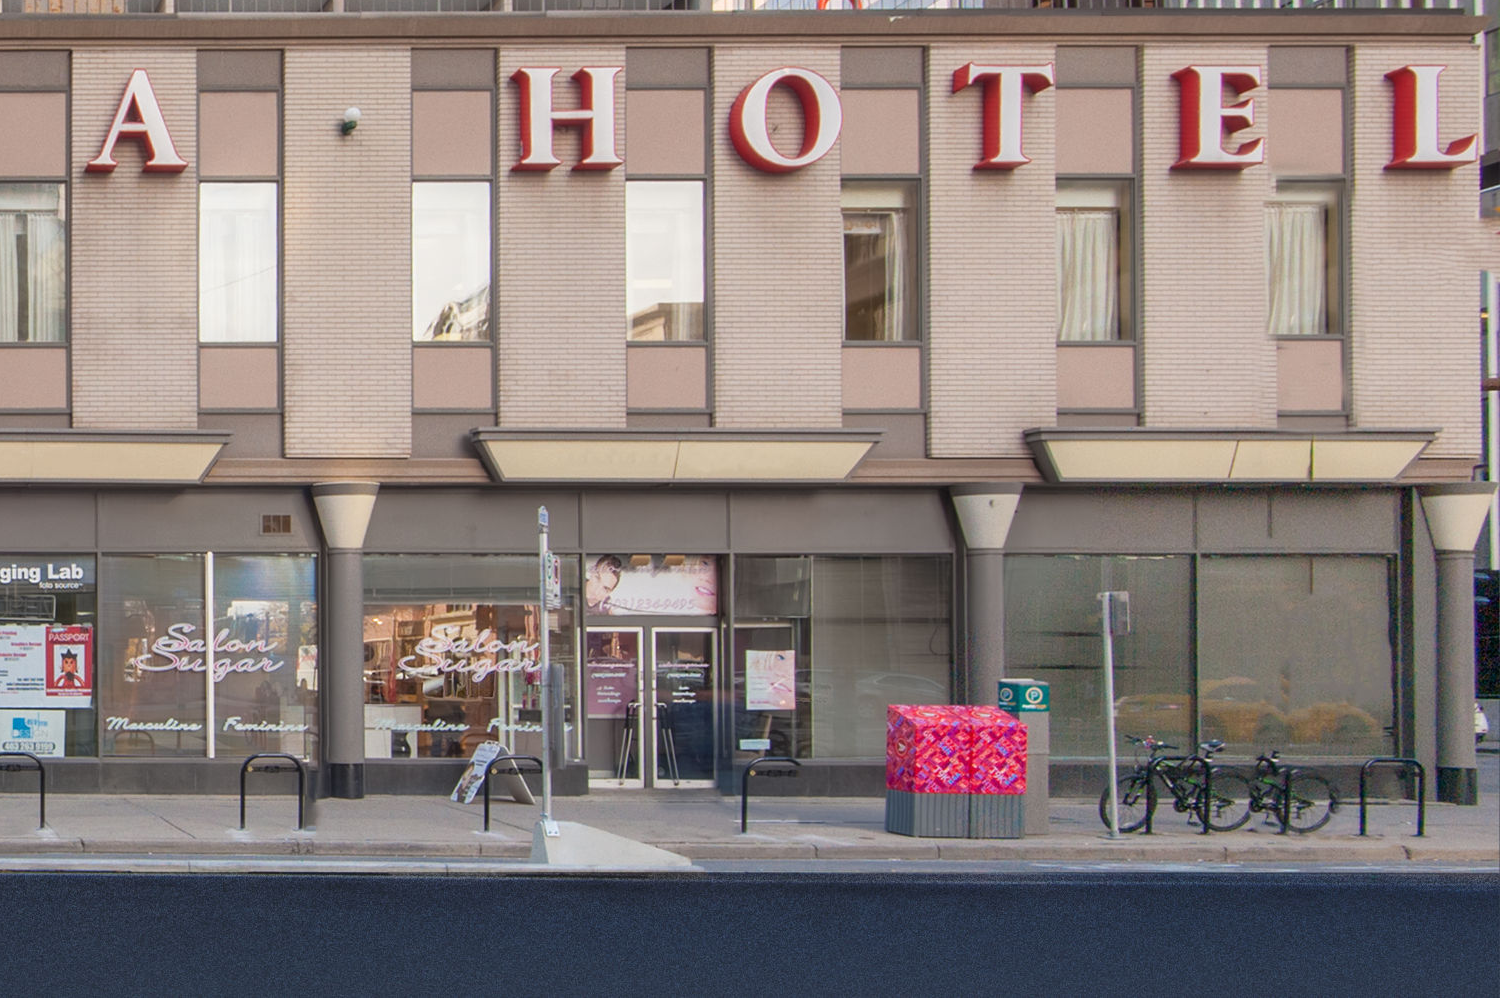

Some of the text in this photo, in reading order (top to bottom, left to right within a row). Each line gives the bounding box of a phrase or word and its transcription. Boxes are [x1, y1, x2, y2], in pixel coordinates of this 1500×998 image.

[509, 62, 1479, 174] HOTEL
[47, 563, 84, 580] Lab
[48, 633, 90, 642] PASSPORT
[154, 623, 278, 653] Salon
[415, 624, 539, 653] Salon
[135, 645, 284, 682] Sugar
[398, 644, 544, 682] Sugar
[106, 716, 309, 732] Masculine Feminine
[374, 717, 470, 732] Masculine
